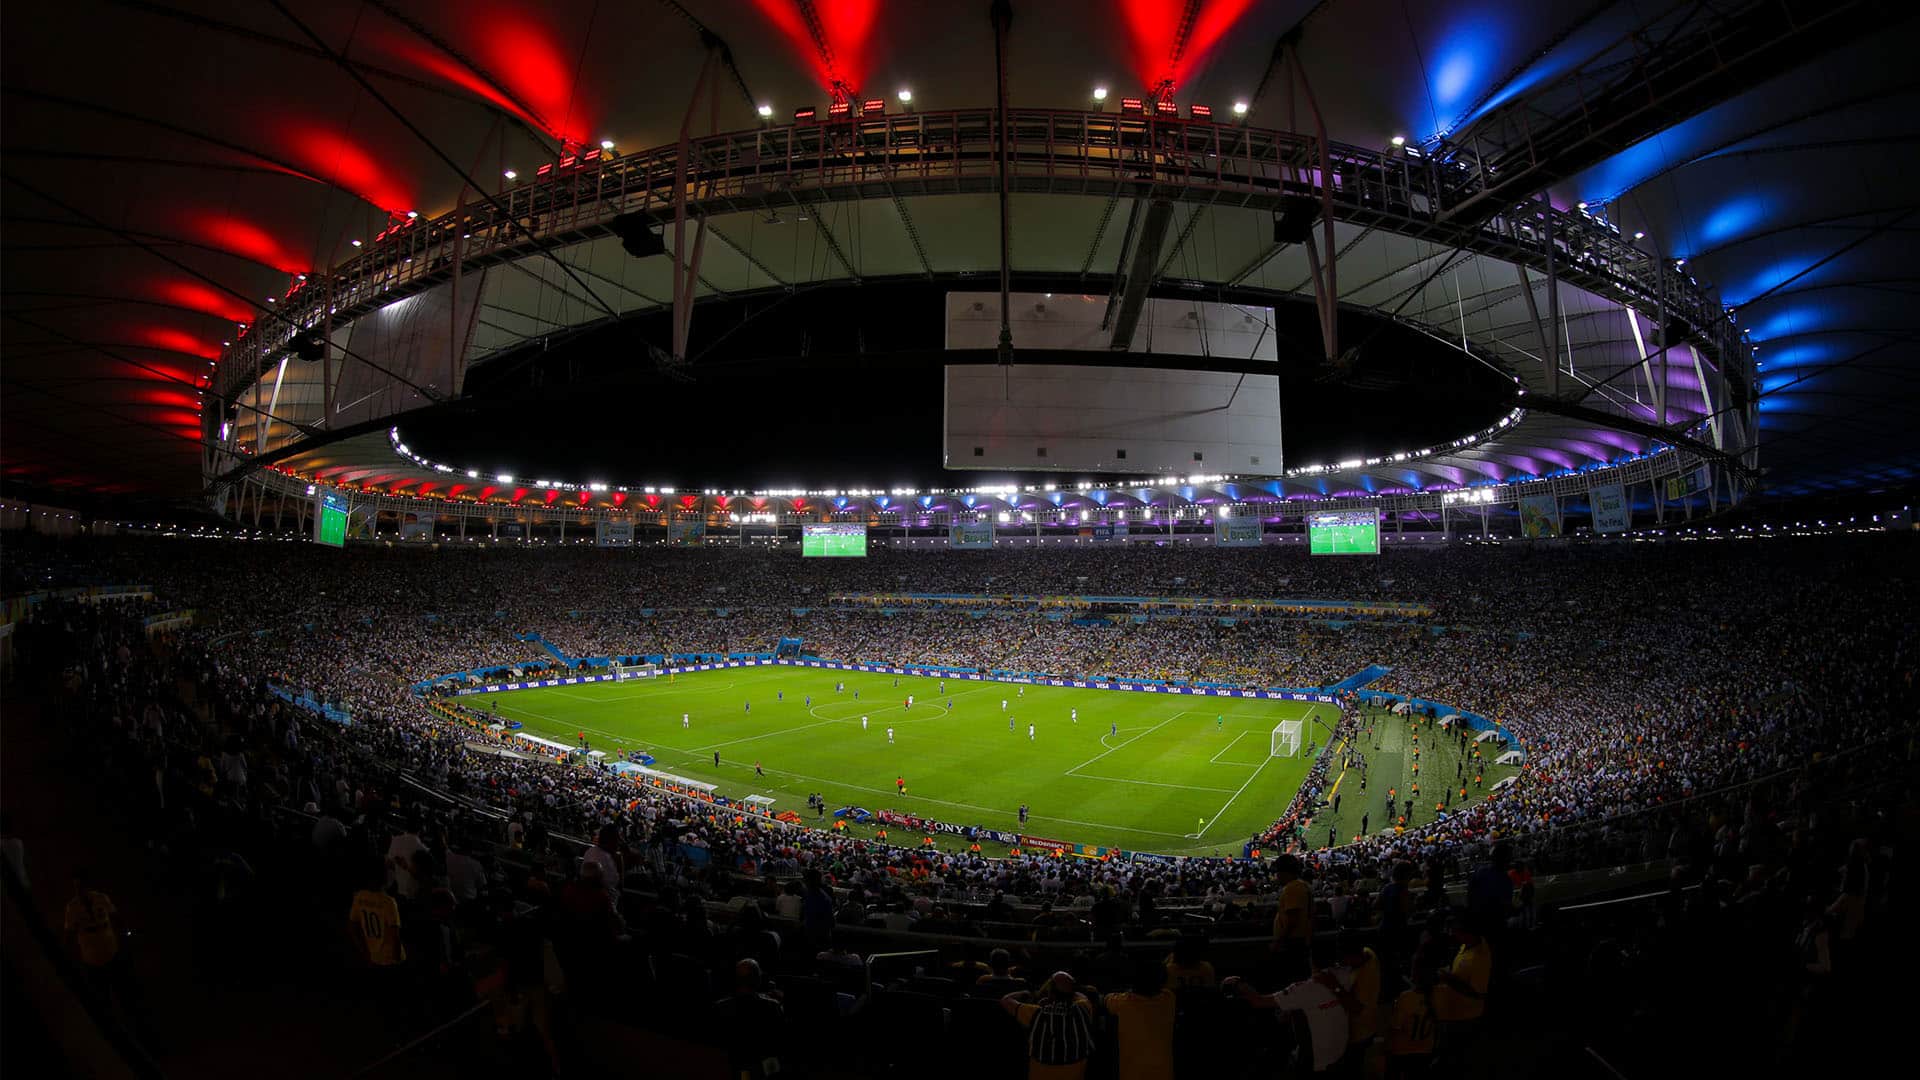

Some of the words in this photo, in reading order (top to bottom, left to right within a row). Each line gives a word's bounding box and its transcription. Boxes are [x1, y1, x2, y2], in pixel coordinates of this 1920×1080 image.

[1598, 519, 1609, 528] The
[1609, 518, 1624, 527] Final
[965, 533, 990, 543] Brasil
[1318, 694, 1333, 702] VISA
[361, 909, 382, 938] 10
